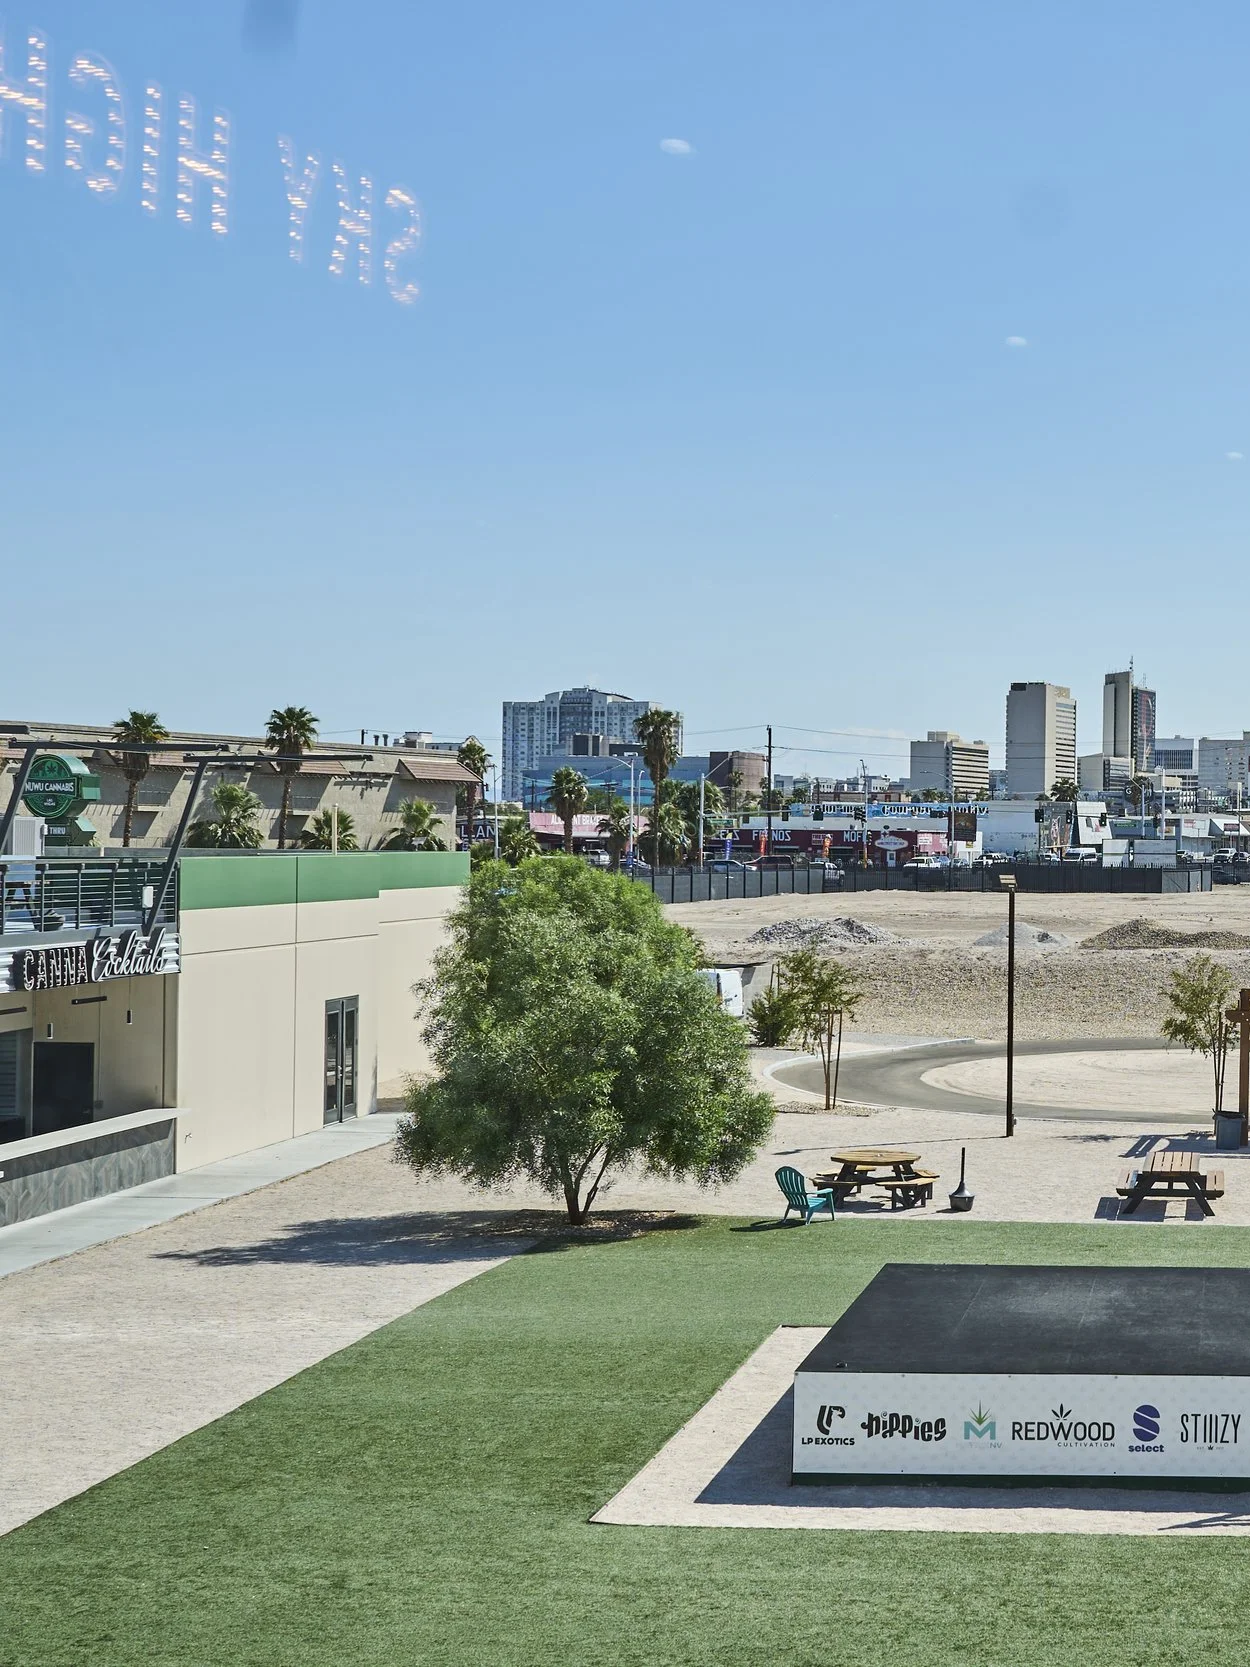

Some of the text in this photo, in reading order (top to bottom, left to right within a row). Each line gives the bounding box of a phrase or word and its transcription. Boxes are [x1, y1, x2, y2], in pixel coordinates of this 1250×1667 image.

[25, 782, 74, 792] NUWU CANNABIS
[49, 827, 66, 835] THRU
[23, 927, 167, 991] CANNA Cocktails
[1011, 1421, 1116, 1442] REDWOOD
[801, 1437, 855, 1446] LP EXOTICS
[1128, 1444, 1165, 1453] select
